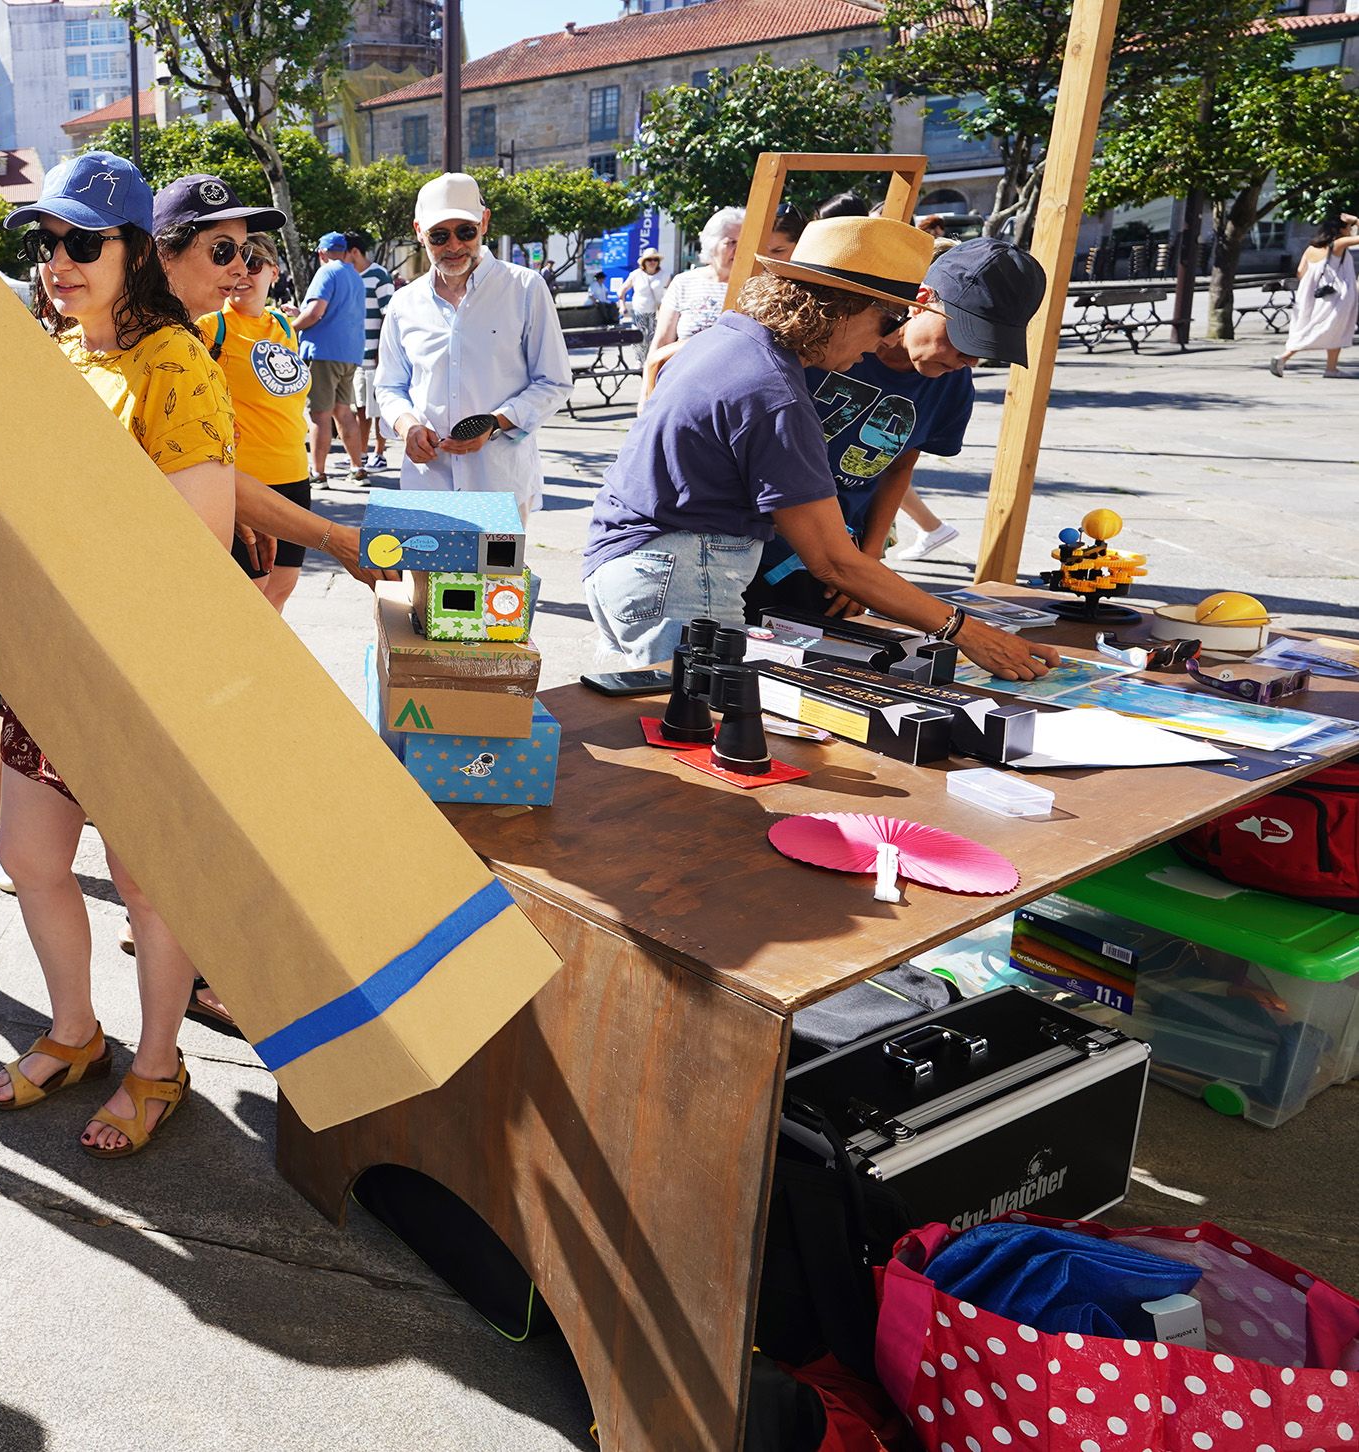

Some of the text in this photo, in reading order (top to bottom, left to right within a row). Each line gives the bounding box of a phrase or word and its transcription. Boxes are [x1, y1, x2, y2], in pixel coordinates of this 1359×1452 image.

[258, 367, 283, 393] GAME
[813, 370, 916, 478] 79
[1016, 953, 1057, 973] ordenación
[1095, 985, 1123, 1009] 11.1
[950, 1165, 1068, 1232] Sky-Watcher
